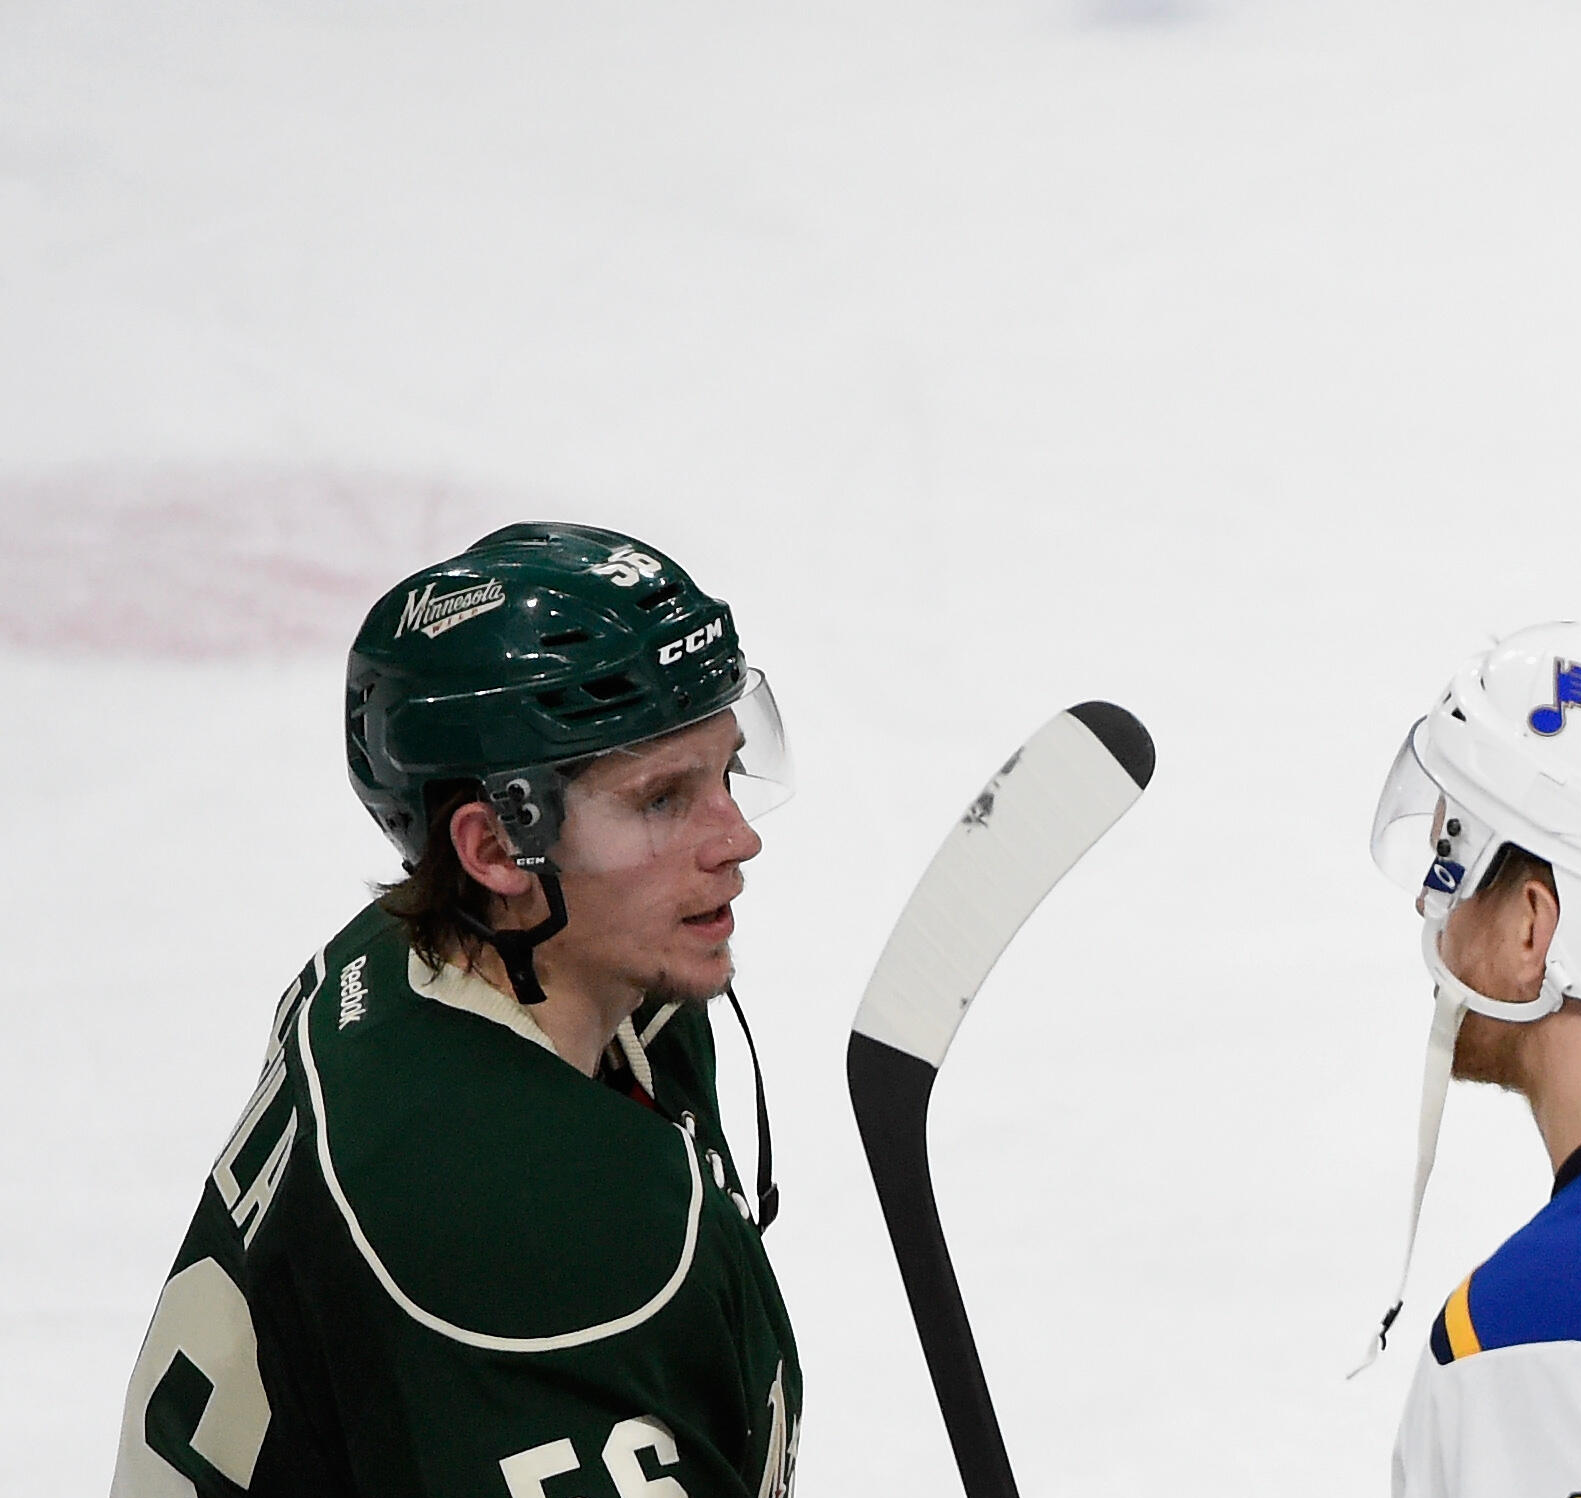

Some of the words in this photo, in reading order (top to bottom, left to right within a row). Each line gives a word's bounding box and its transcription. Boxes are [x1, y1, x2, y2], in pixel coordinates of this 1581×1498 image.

[394, 577, 504, 639] Minnesota
[658, 618, 722, 665] CCM
[516, 856, 545, 866] CCM
[338, 955, 367, 1031] Reebok
